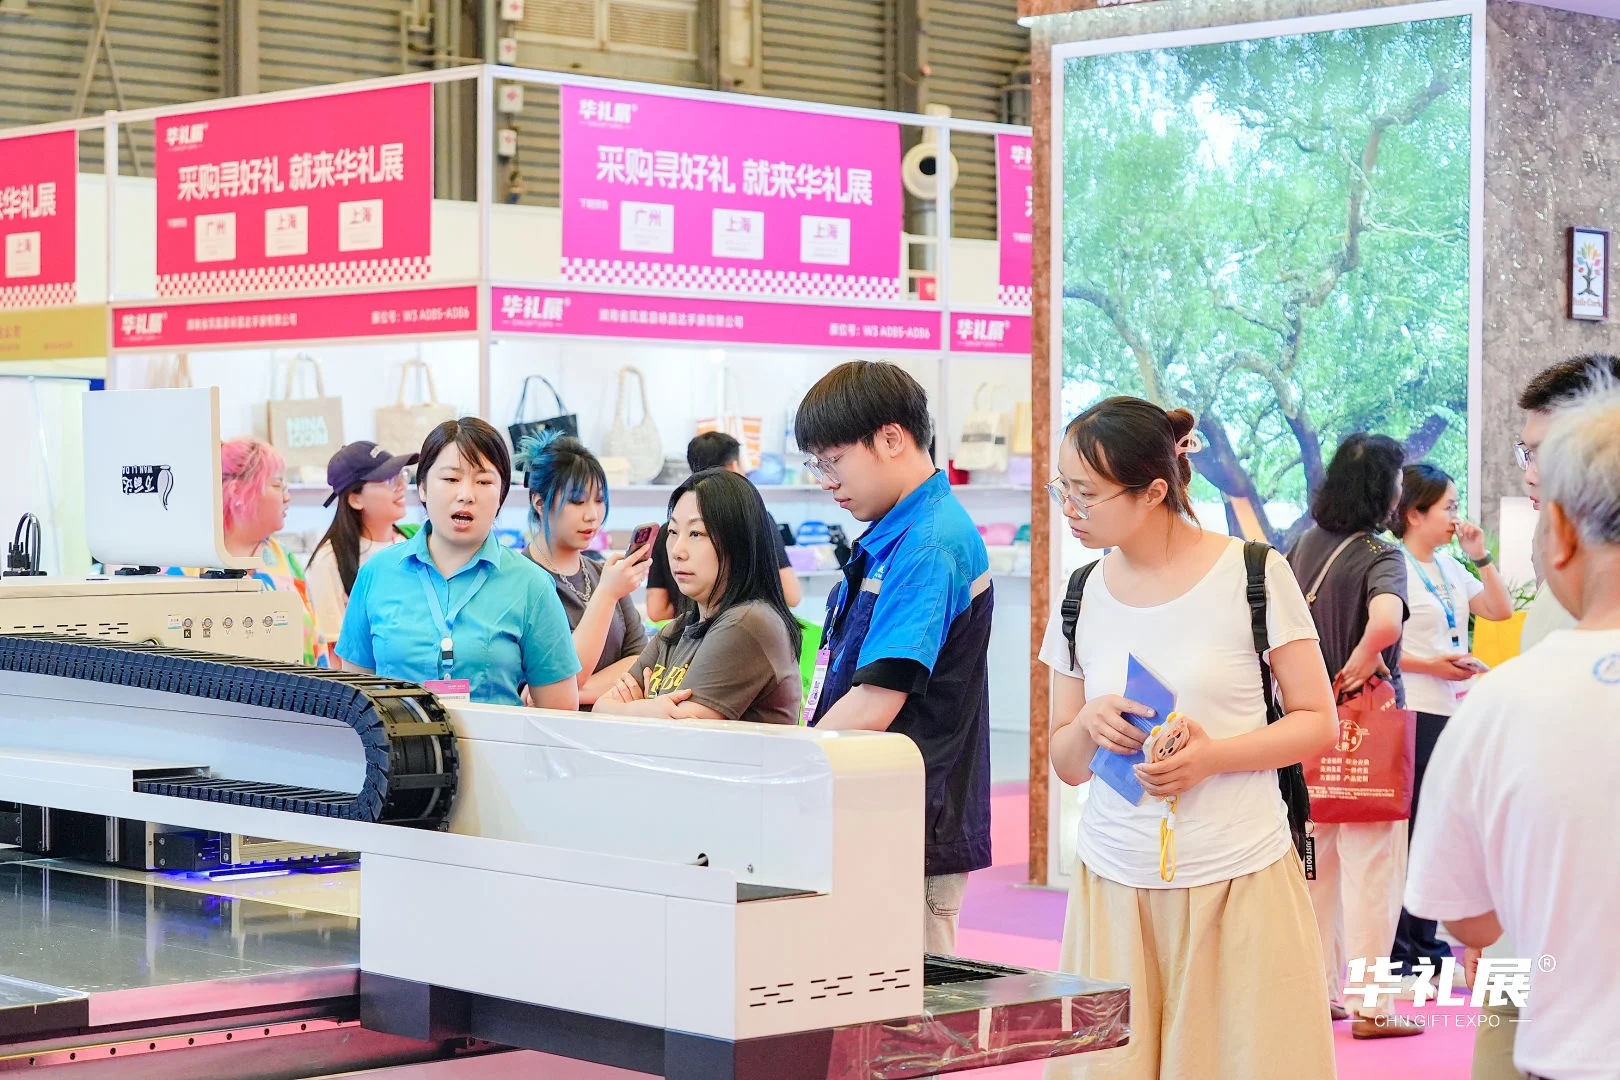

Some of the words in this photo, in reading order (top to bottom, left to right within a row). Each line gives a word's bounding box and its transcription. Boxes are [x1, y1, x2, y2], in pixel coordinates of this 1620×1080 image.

[177, 155, 284, 202] 采购寻好礼
[288, 142, 404, 192] 就来华礼展
[596, 144, 736, 194] 采购寻好礼
[742, 157, 873, 206] 就来华礼展
[0, 181, 56, 220] 华礼展
[634, 209, 662, 228] 广州
[725, 215, 752, 233] 上海
[813, 223, 839, 240] 上海
